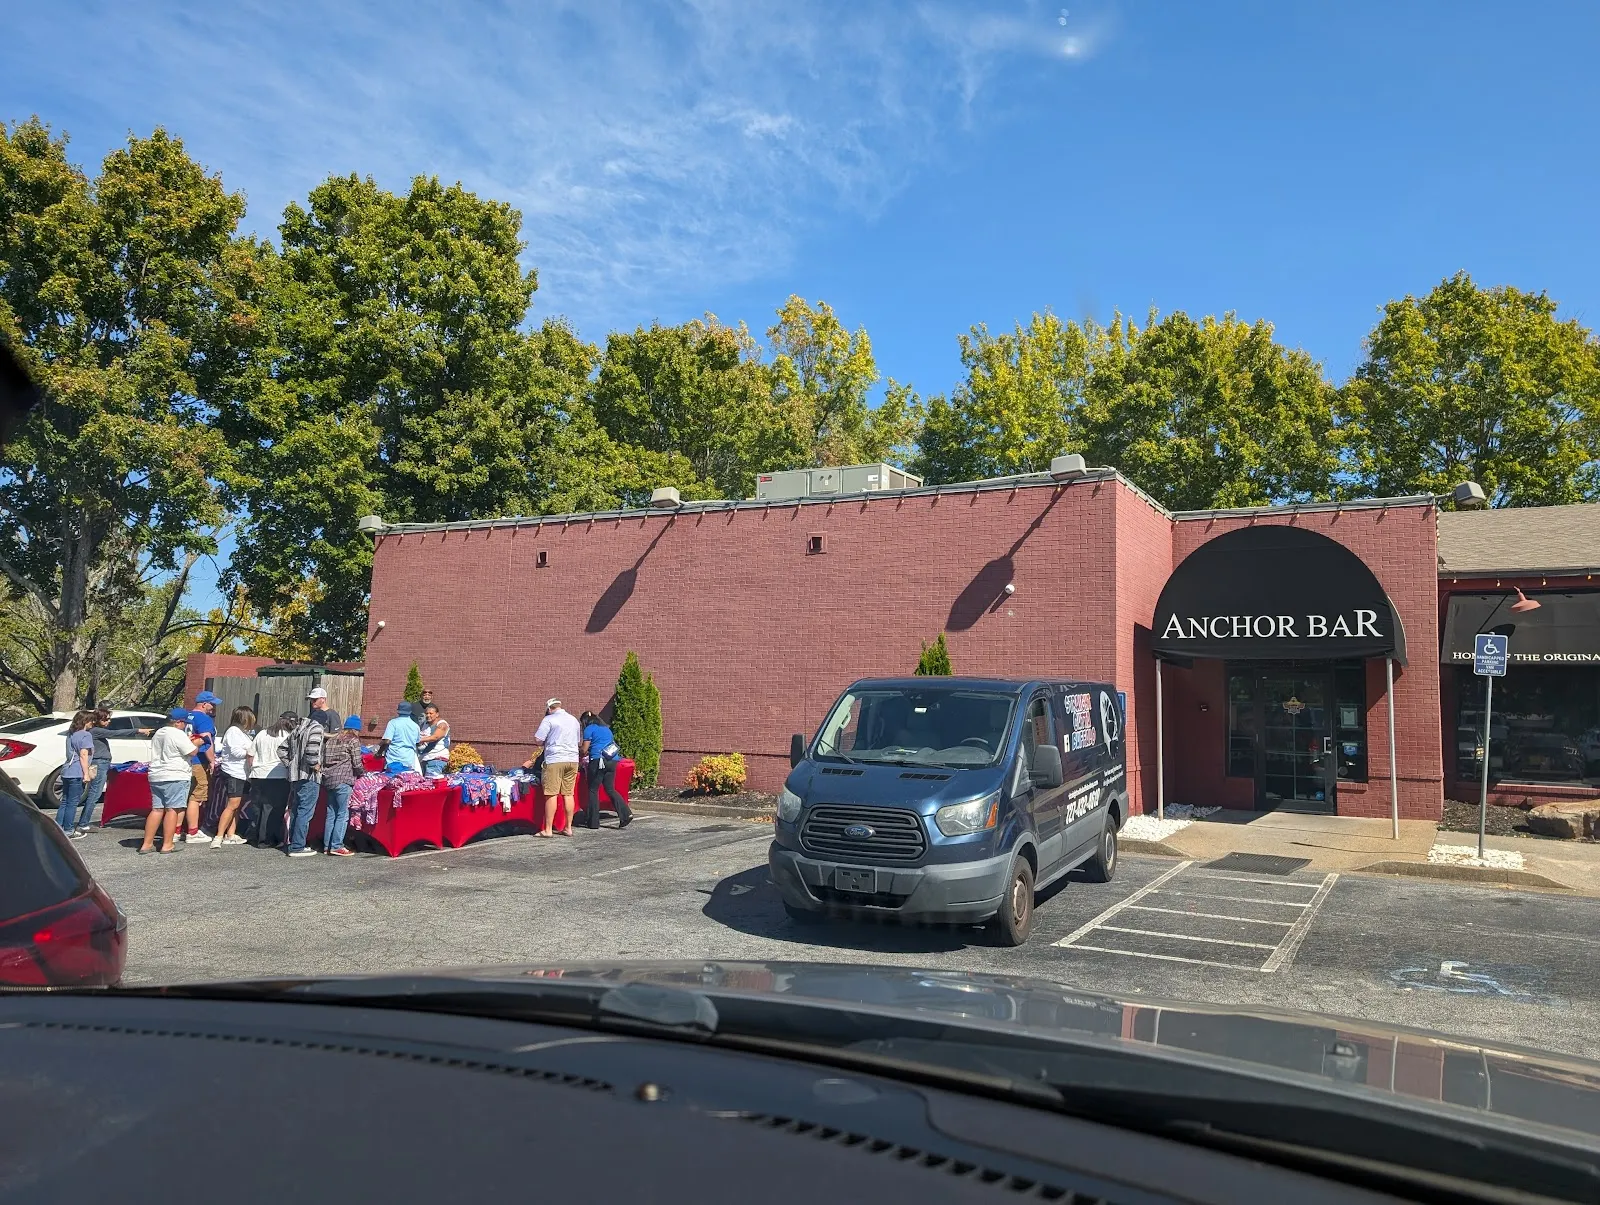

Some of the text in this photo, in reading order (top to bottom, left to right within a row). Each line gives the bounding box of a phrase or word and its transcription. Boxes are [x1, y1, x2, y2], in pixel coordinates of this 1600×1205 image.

[1160, 609, 1384, 639] ANCHOR BAR
[1453, 652, 1475, 660] HO
[1514, 653, 1541, 661] THE
[1543, 653, 1600, 662] ORIGINA
[850, 827, 866, 836] Ford
